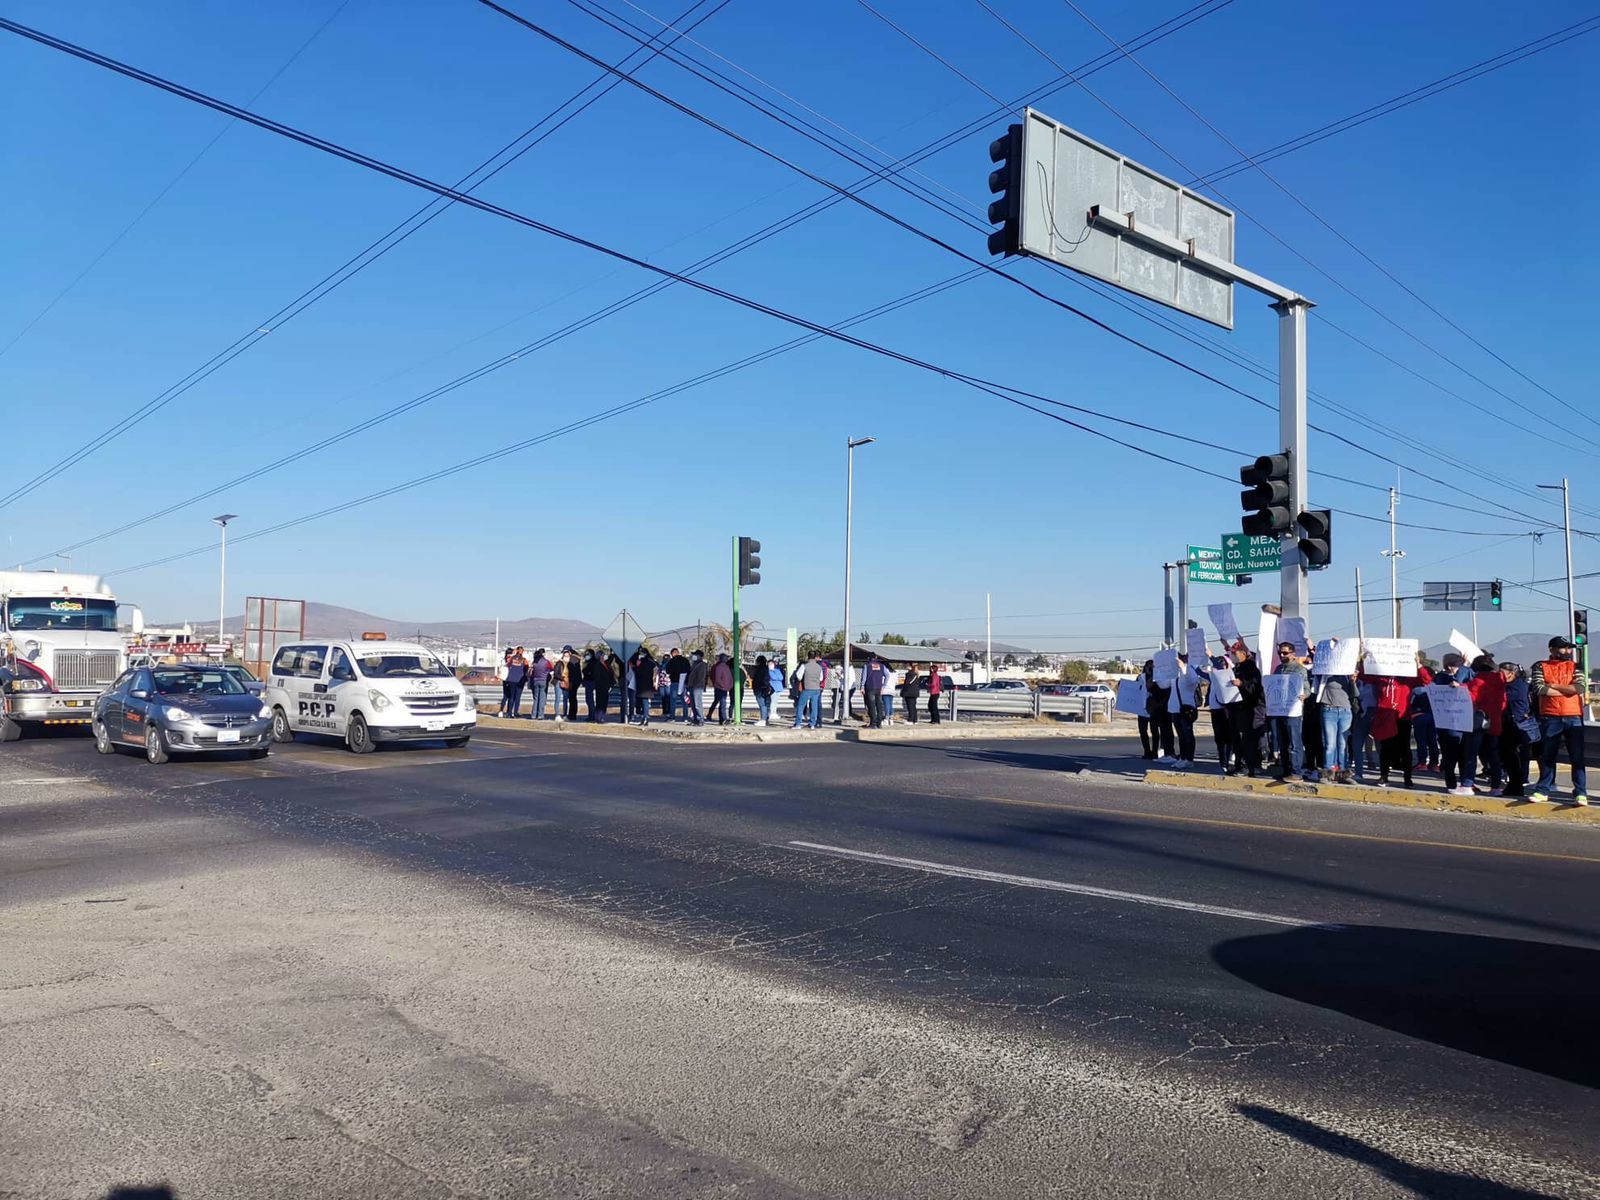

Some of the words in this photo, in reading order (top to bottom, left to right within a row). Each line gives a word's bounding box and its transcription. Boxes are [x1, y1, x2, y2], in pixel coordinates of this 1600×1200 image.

[1250, 535, 1280, 545] MEX
[1227, 550, 1243, 559] CD.
[1226, 561, 1246, 570] Blvd.
[1247, 560, 1274, 569] Nuevo
[298, 701, 336, 718] P.C.P
